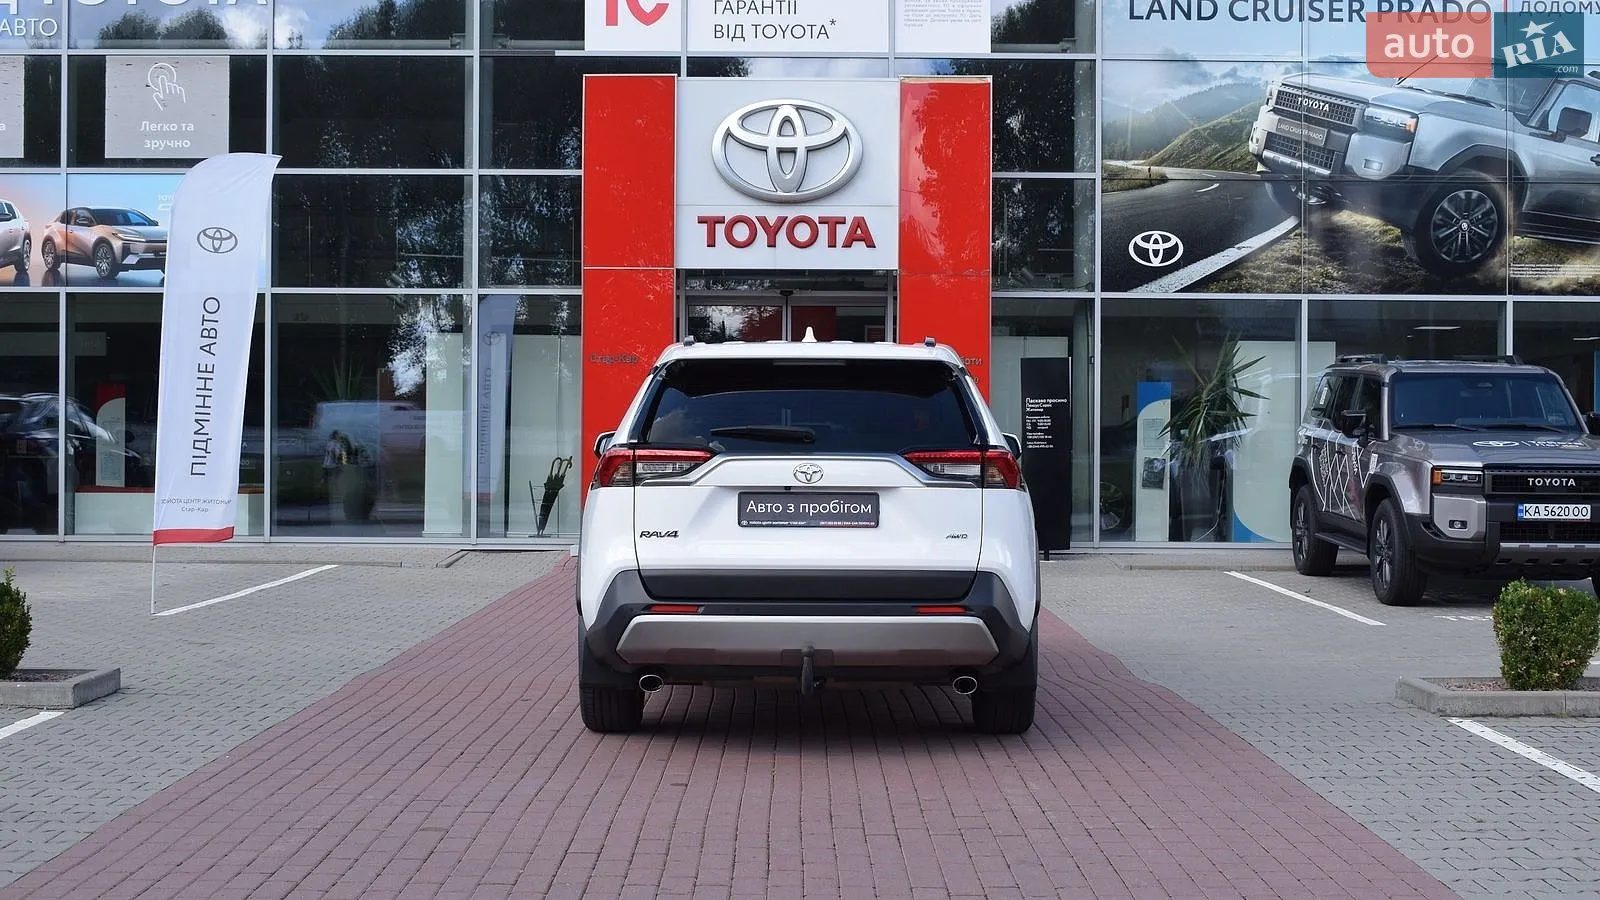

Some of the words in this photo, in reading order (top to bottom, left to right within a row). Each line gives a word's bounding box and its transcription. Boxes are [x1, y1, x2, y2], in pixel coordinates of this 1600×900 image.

[1129, 0, 1219, 21] LAND
[1228, 0, 1366, 23] CRUISER
[1377, 0, 1492, 25] PRADO
[0, 18, 57, 37] АВТО
[713, 24, 746, 42] ВІД
[1297, 97, 1330, 112] TOYOTA
[140, 121, 178, 132] Легко
[180, 123, 194, 132] та
[143, 138, 192, 150] зручно
[697, 214, 877, 249] TOYOTA
[199, 295, 222, 357] АВТО
[190, 362, 216, 477] ПІДМІННЕ
[1527, 477, 1577, 487] TOYOTA
[746, 500, 783, 513] Авто
[786, 503, 796, 513] з
[799, 499, 873, 517] пробігом
[1524, 505, 1541, 517] KA
[1543, 505, 1570, 518] 5620
[640, 530, 680, 539] RAV4
